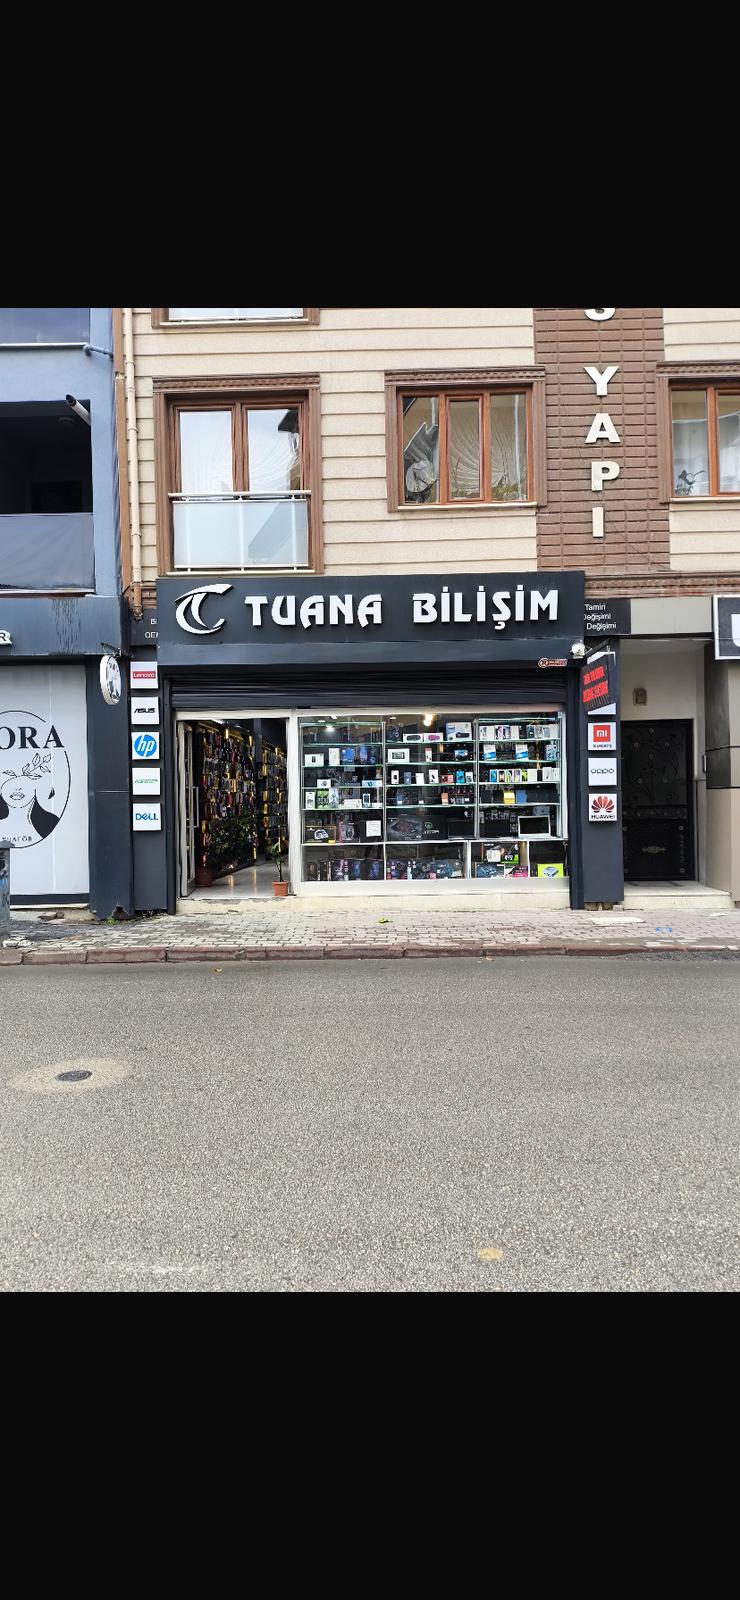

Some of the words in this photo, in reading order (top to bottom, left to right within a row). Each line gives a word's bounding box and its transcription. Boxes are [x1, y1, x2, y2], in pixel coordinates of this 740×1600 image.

[583, 365, 621, 538] YAPI
[244, 593, 383, 629] TUANA
[412, 584, 559, 631] BİLİŞİM
[137, 734, 155, 757] hp
[135, 812, 159, 821] DELL
